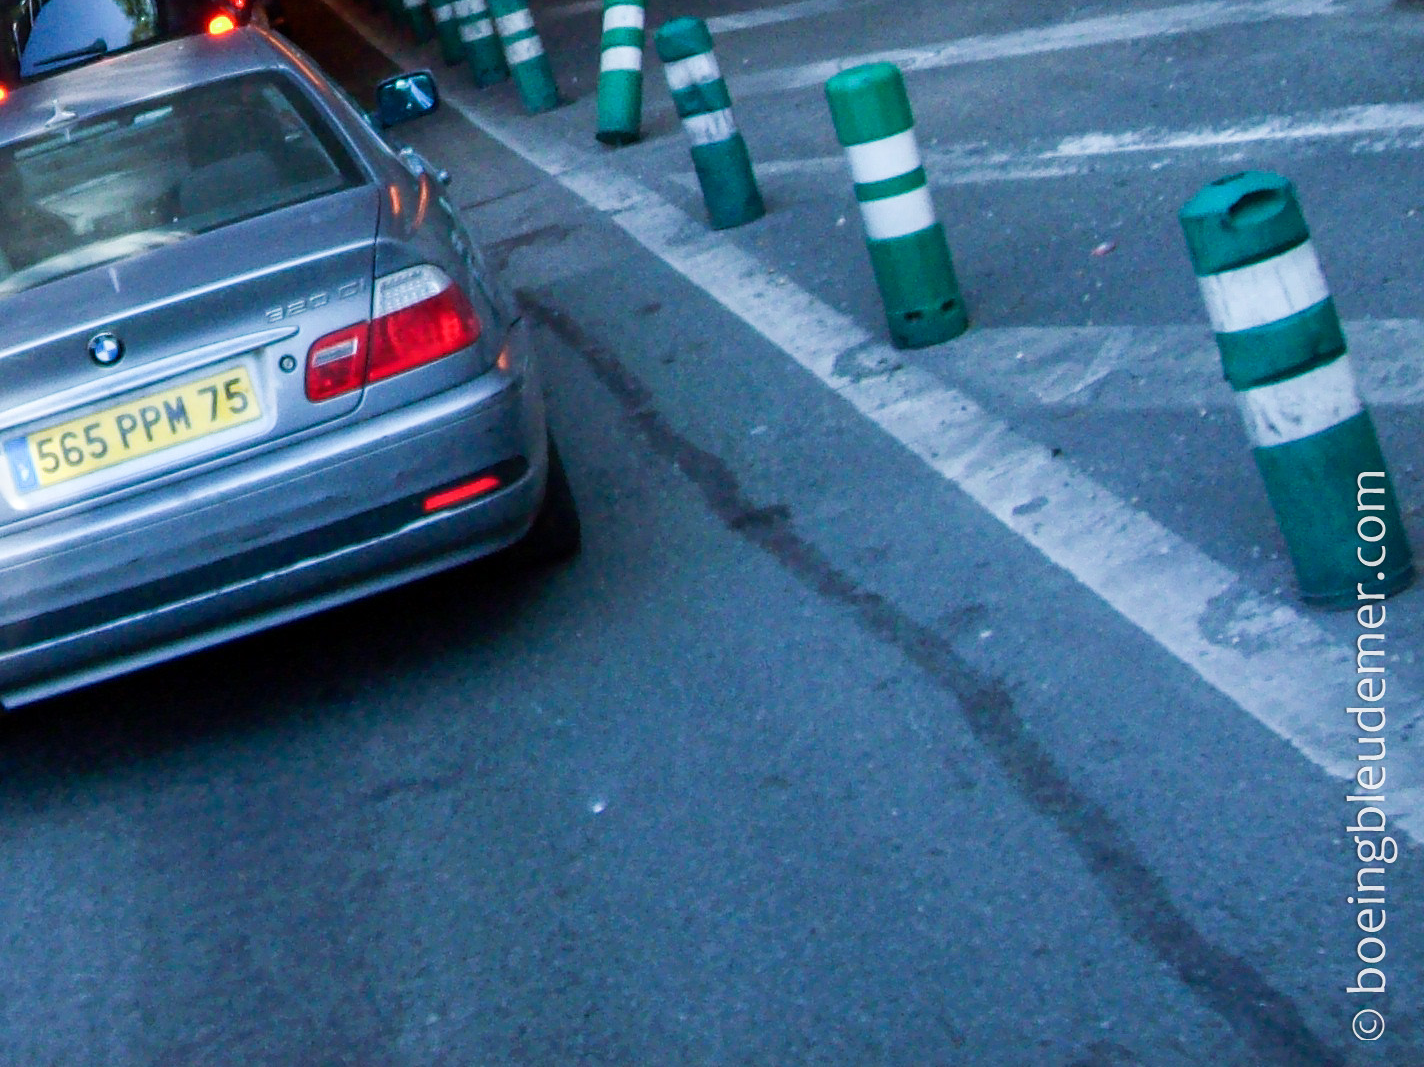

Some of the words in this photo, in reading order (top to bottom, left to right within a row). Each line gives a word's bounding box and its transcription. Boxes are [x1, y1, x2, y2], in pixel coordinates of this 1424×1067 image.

[37, 423, 108, 474] 565
[116, 395, 192, 449] PPM
[197, 377, 249, 422] 75
